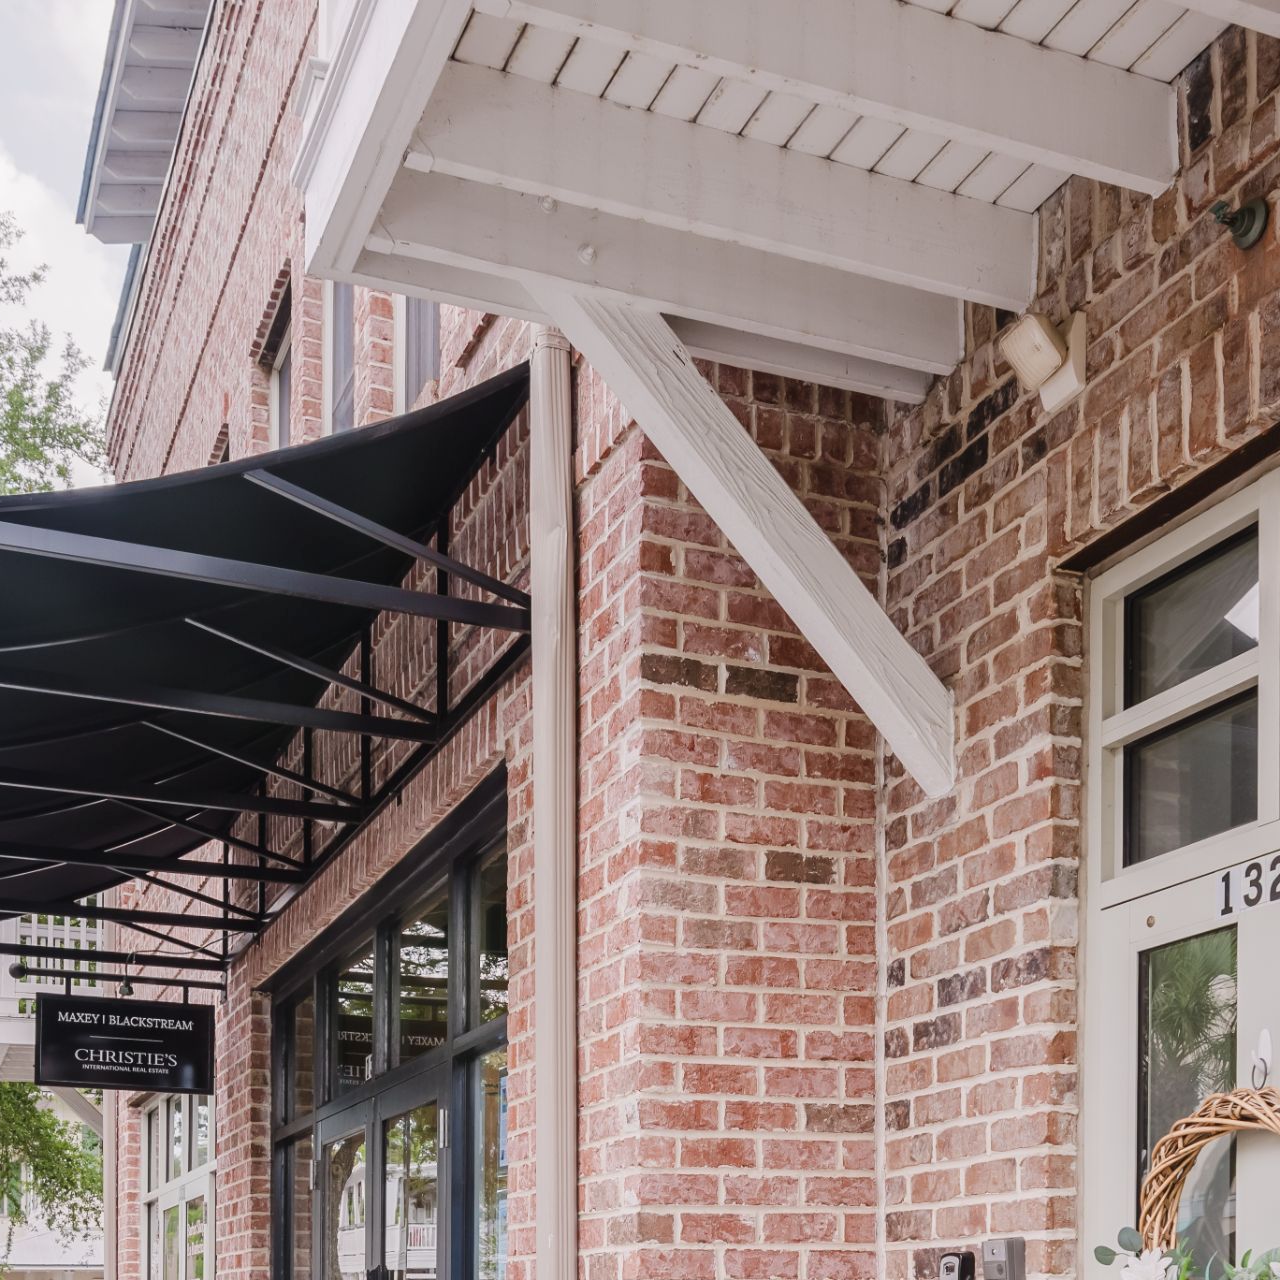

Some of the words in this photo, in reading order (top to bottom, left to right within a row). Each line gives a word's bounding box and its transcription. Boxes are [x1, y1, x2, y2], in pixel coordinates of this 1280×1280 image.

[57, 1010, 100, 1024] MAXEY
[108, 1014, 194, 1031] BLACKSTREAM
[74, 1048, 178, 1067] CHRISTIE'S
[82, 1063, 131, 1073] INTERNATIONAL
[132, 1066, 148, 1074] REAL
[148, 1067, 170, 1075] ESTATE
